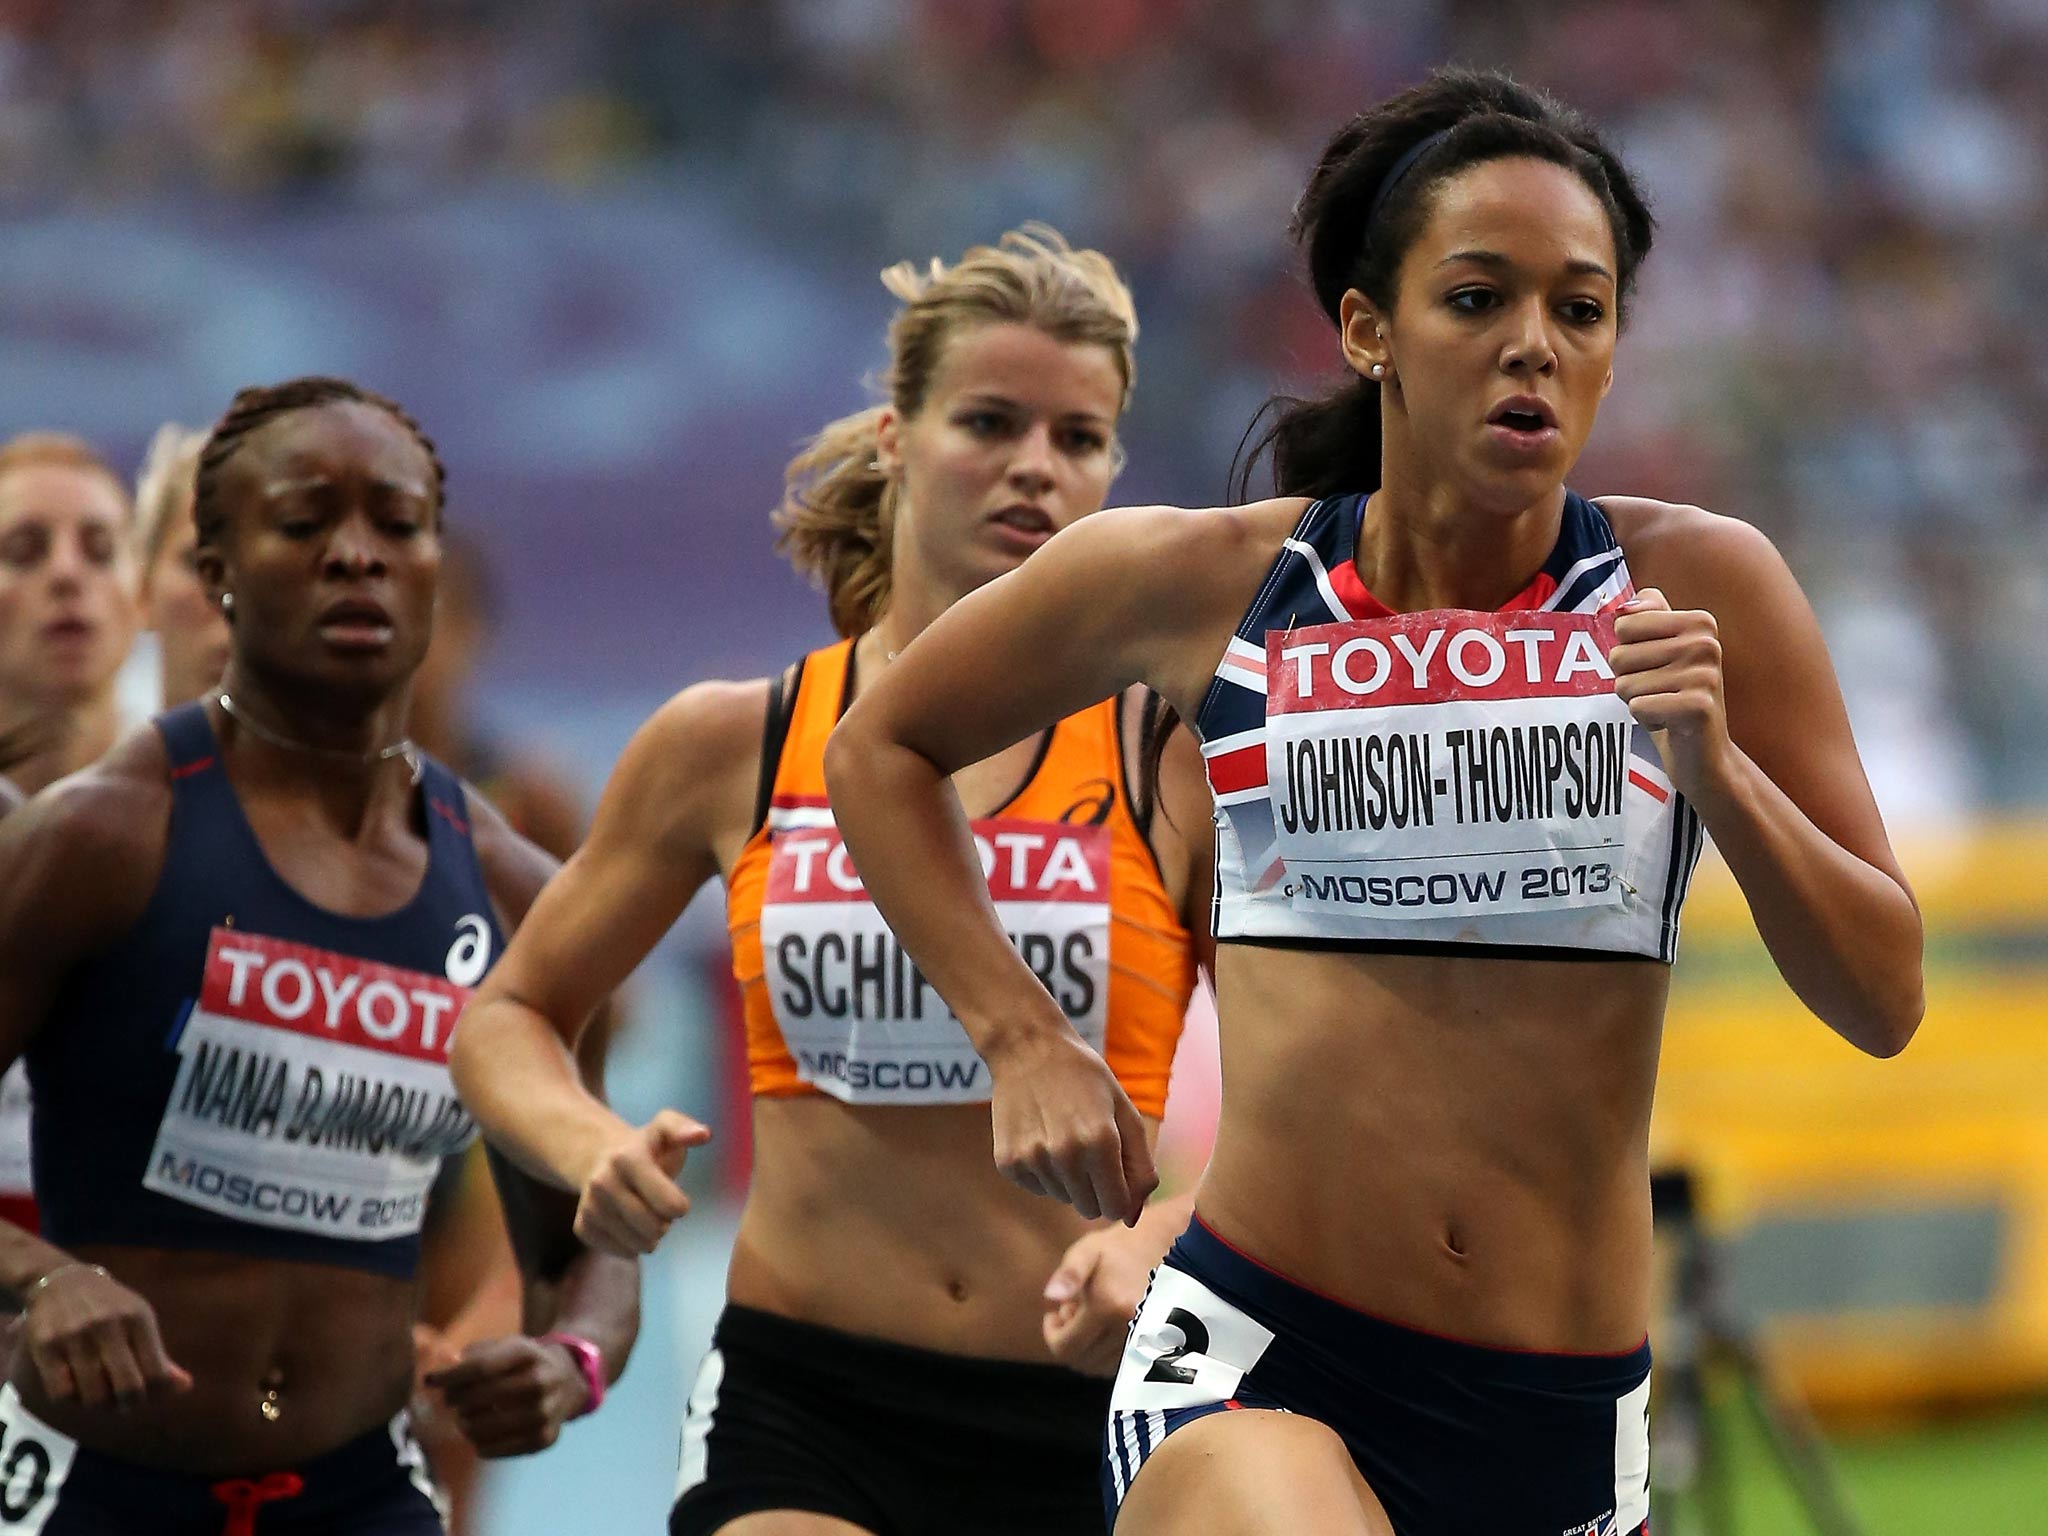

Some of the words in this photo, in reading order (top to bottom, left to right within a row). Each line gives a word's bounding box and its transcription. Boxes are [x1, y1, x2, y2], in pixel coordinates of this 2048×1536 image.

[1281, 628, 1616, 698] TOYOTA
[1281, 721, 1625, 835] JOHNSON-THOMPSON
[783, 833, 1097, 892] TOTA
[1301, 870, 1508, 907] MOSCOW
[1521, 863, 1612, 900] 2013
[218, 948, 466, 1052] TOYOT
[180, 1040, 288, 1138] NANA
[157, 1152, 351, 1223] MOSCOW
[1143, 1307, 1210, 1384] 2
